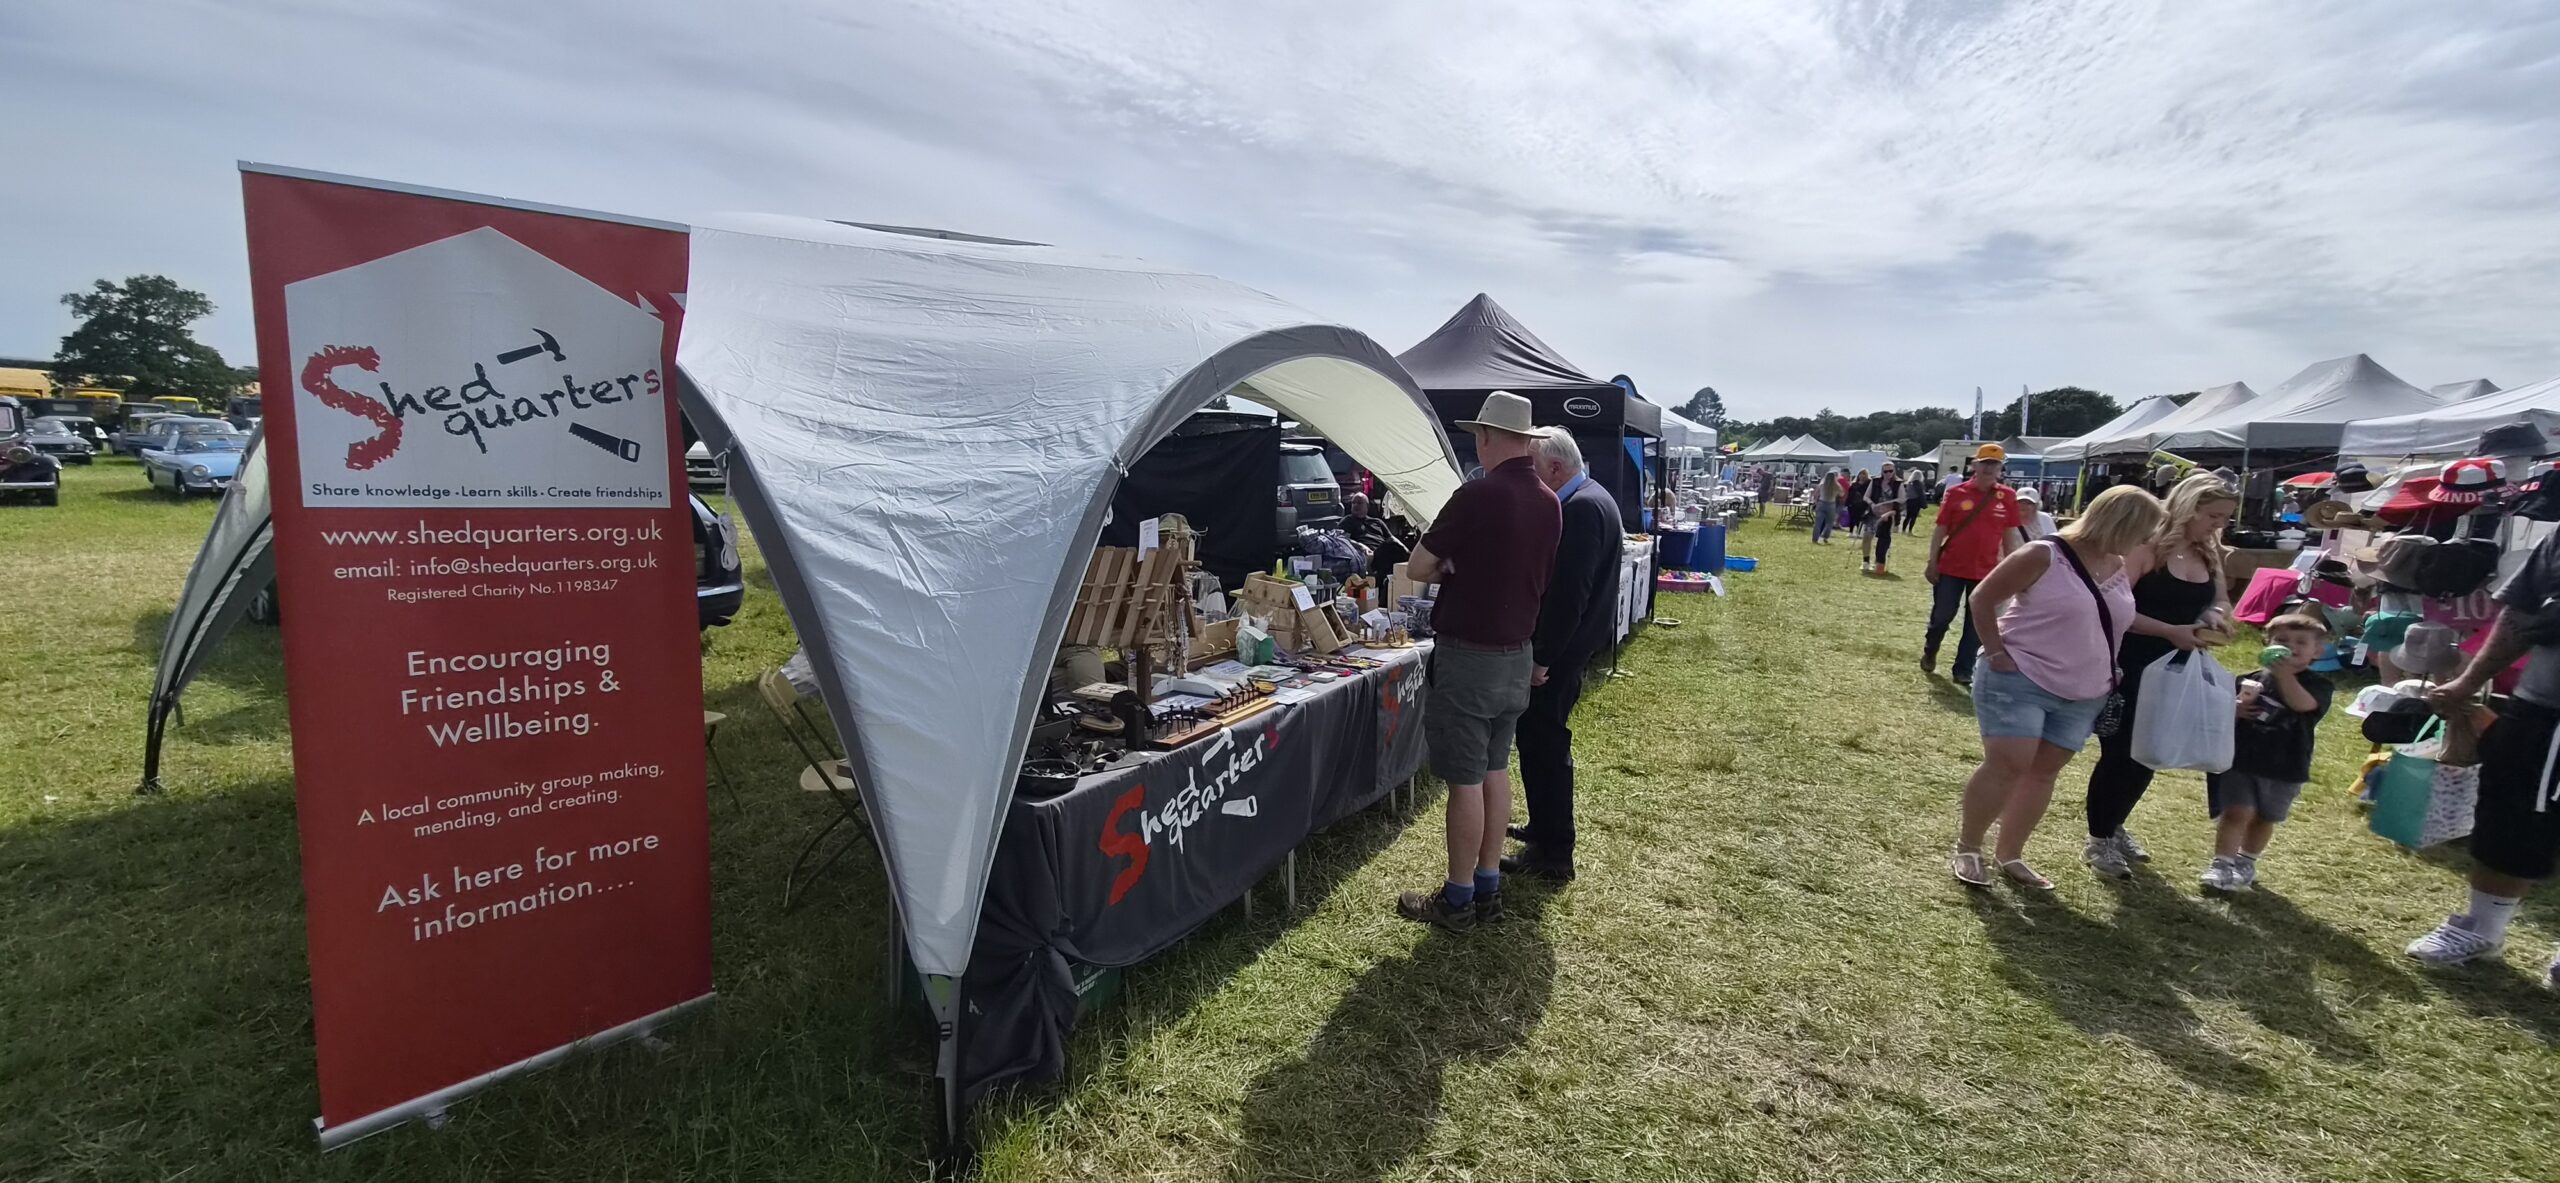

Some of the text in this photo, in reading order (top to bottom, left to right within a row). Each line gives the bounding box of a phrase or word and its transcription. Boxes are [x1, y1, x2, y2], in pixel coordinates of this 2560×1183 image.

[301, 344, 505, 471] Shed
[443, 369, 661, 455] quarters
[311, 484, 663, 501] Share knowledge Learn skills Create friendships
[321, 519, 663, 548] www.shedquarters.org.uk
[334, 552, 658, 580] email: info@shedquarters.org.uk
[388, 584, 467, 605] Registered
[472, 583, 526, 600] Charity
[408, 640, 610, 678] Encouraging
[401, 670, 621, 716] Friendships &
[426, 711, 600, 748] Wellbeing.
[356, 763, 665, 826] A local community group making,
[1168, 725, 1281, 854] quarters
[414, 789, 623, 838] mending, and creating.
[1098, 767, 1201, 906] Shed
[377, 835, 660, 913] Ask here for more
